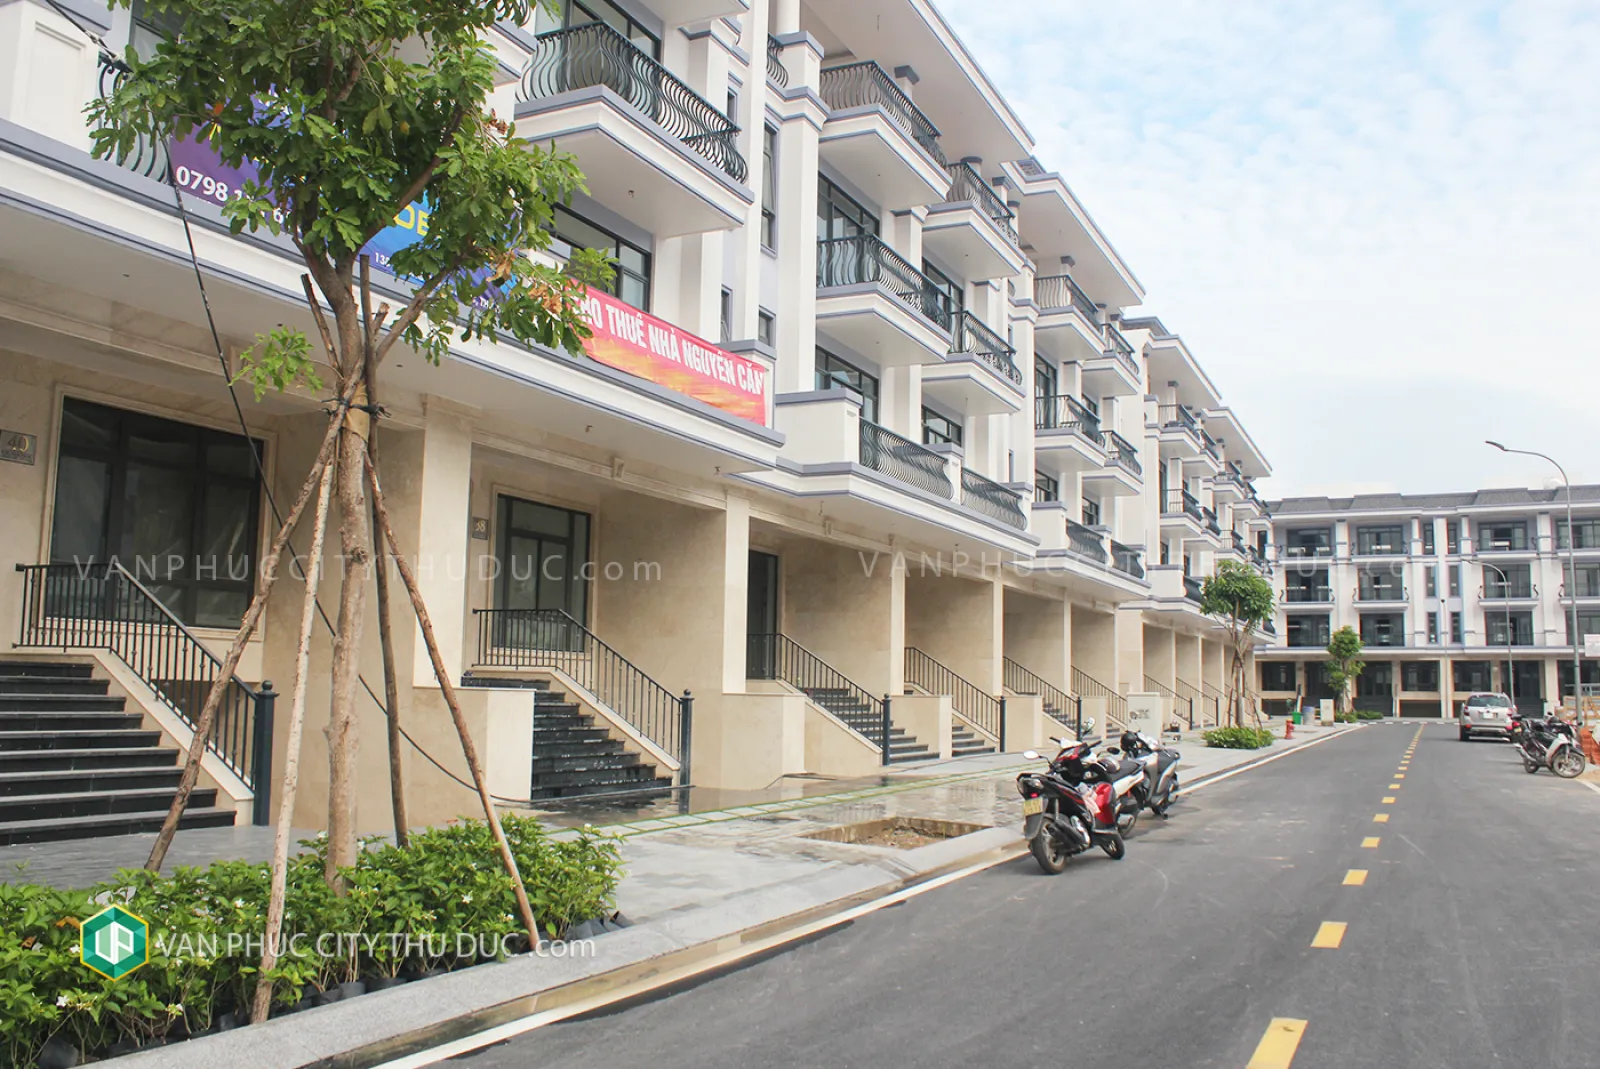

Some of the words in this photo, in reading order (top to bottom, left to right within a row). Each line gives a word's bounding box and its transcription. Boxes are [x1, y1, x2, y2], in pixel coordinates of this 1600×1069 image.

[176, 166, 228, 202] 0798
[605, 304, 647, 349] THUÊ
[648, 322, 681, 363] NHÀ
[682, 339, 736, 387] NGUYÊN
